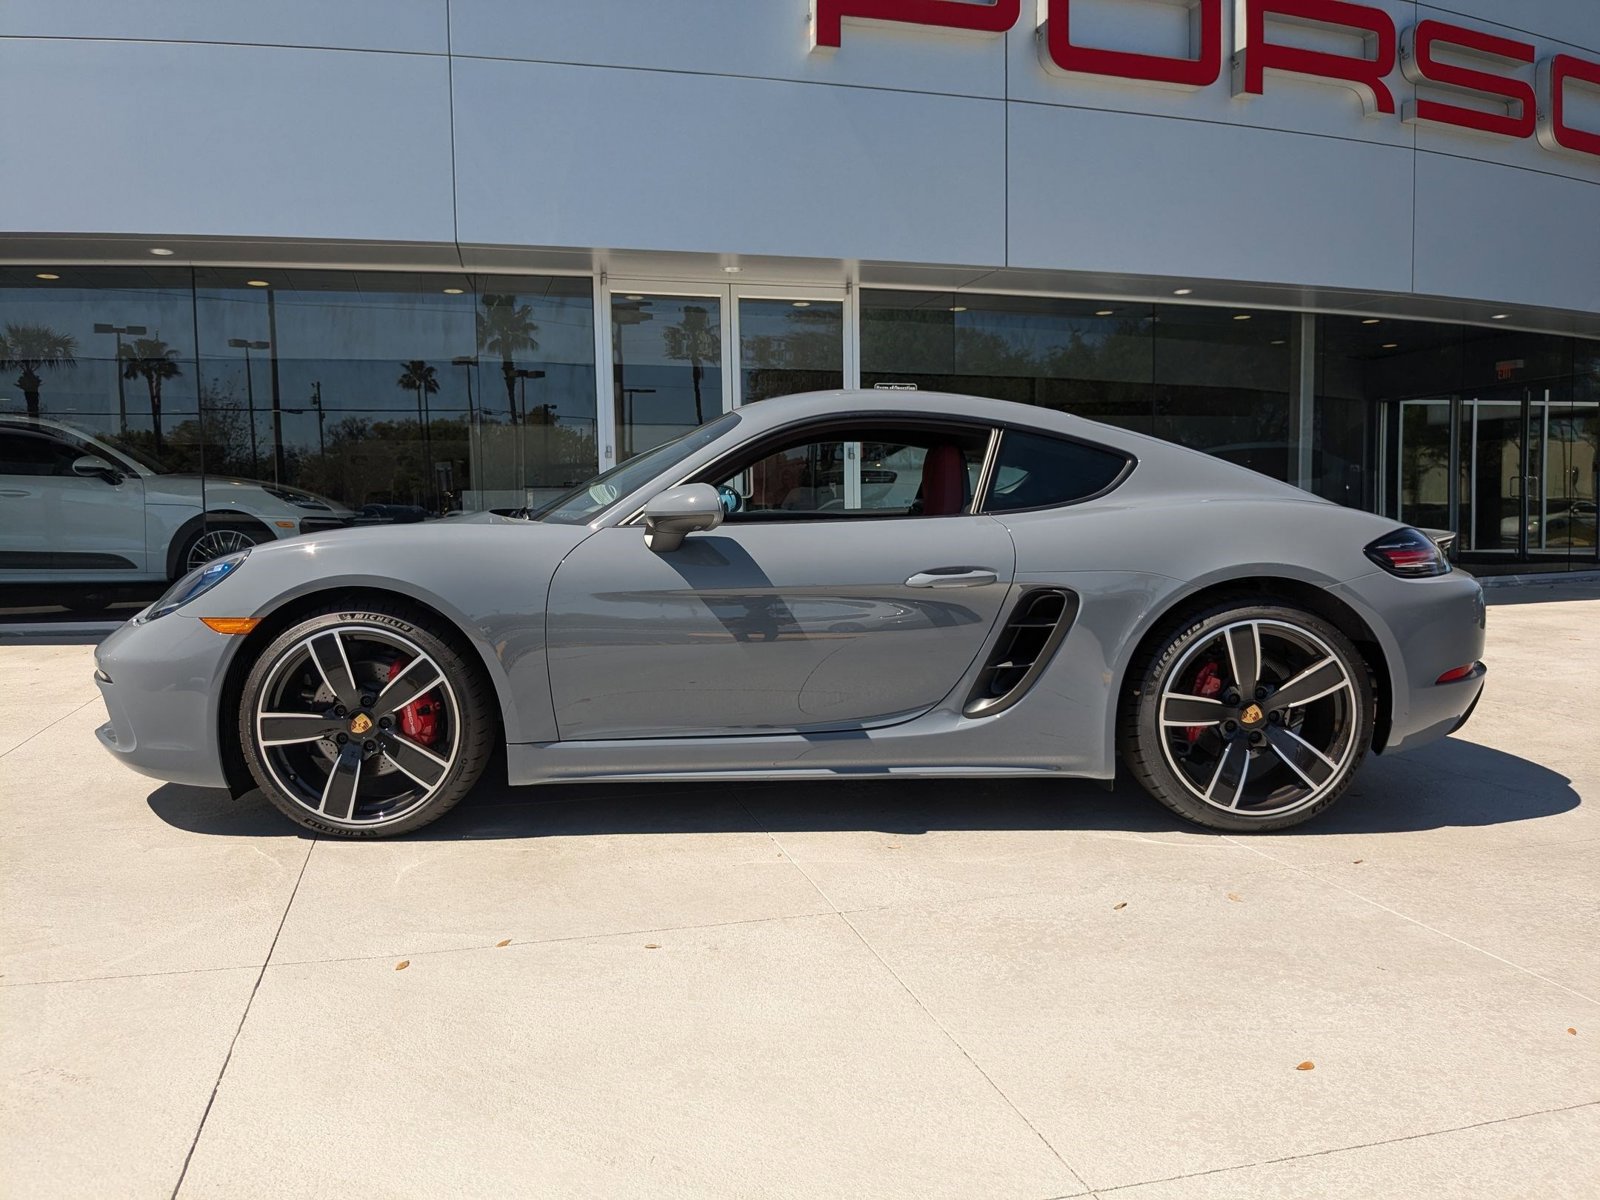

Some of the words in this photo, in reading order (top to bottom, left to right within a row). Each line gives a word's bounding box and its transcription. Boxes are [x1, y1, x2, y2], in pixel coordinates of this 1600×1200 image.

[353, 612, 411, 632] MICHELIN
[1152, 622, 1202, 679] MICHELIN
[307, 819, 363, 837] MICHELIN
